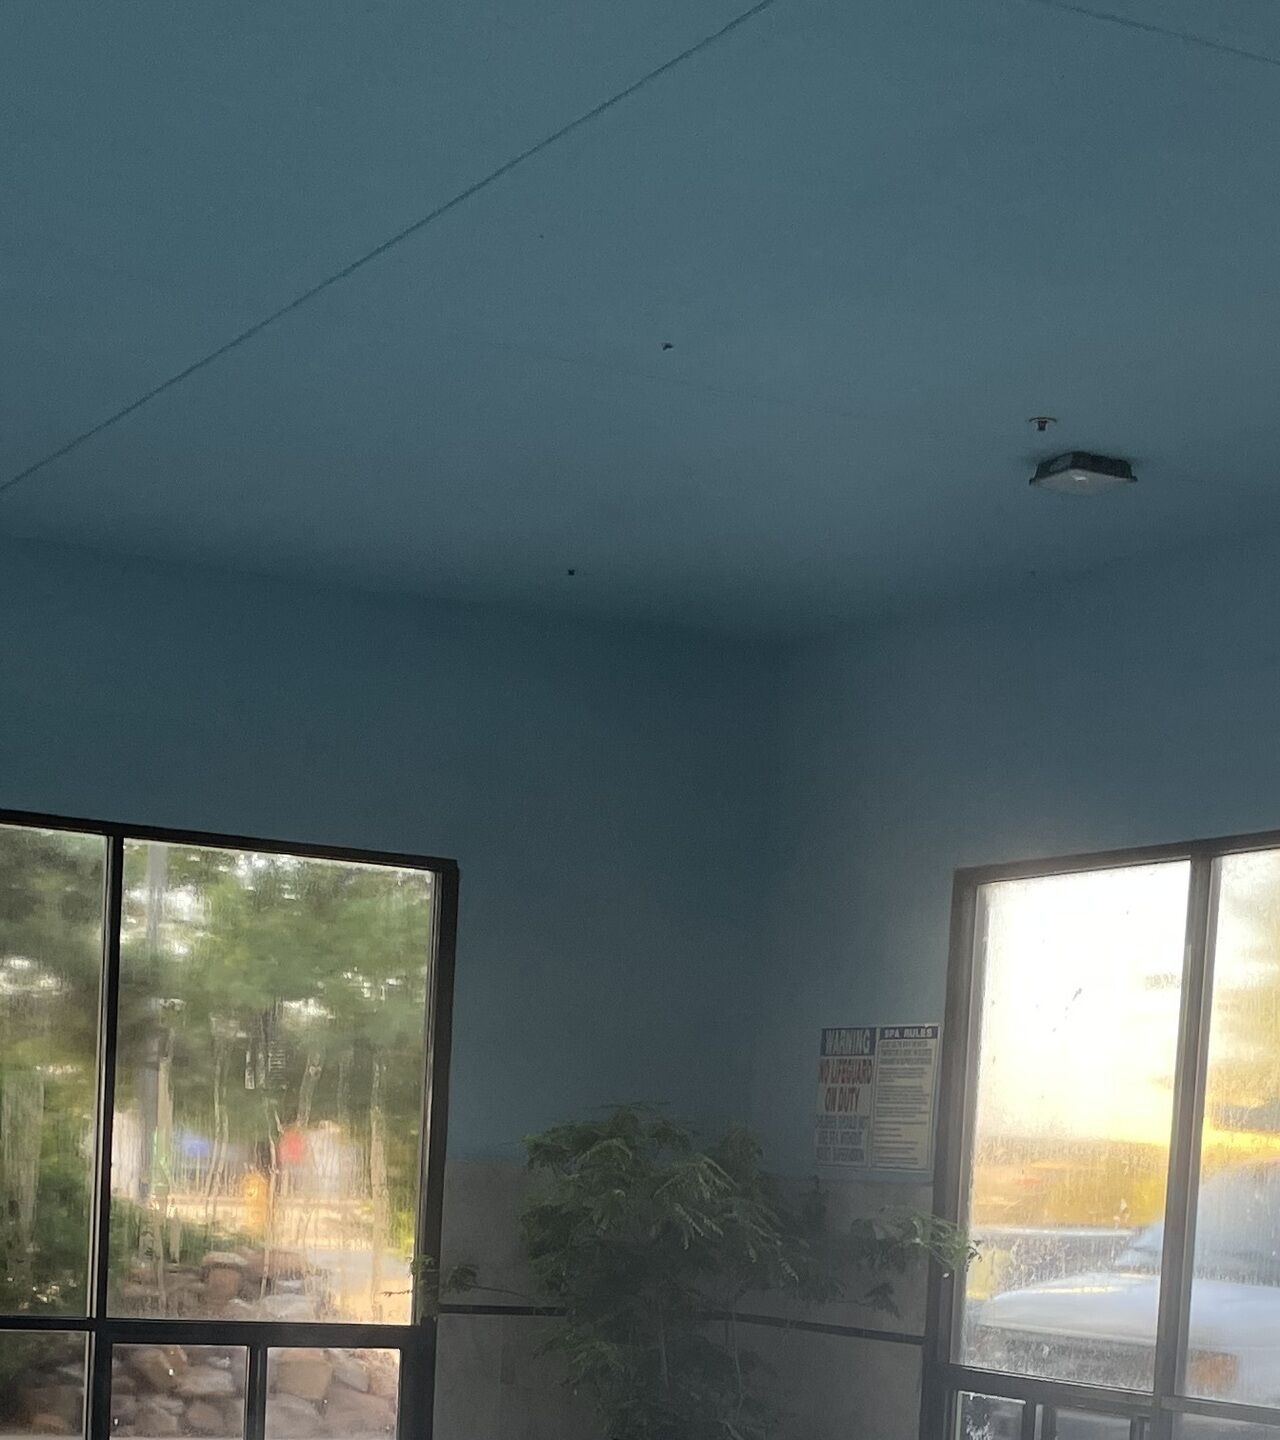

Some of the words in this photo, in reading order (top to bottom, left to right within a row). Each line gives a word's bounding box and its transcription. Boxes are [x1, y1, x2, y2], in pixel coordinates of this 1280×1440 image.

[825, 1029, 870, 1055] WARNING
[884, 1030, 900, 1038] SPA
[904, 1028, 933, 1038] RULES
[819, 1059, 829, 1085] NO
[830, 1059, 872, 1084] LIFEGUARD
[825, 1087, 837, 1112] ON
[838, 1087, 860, 1112] DUTY
